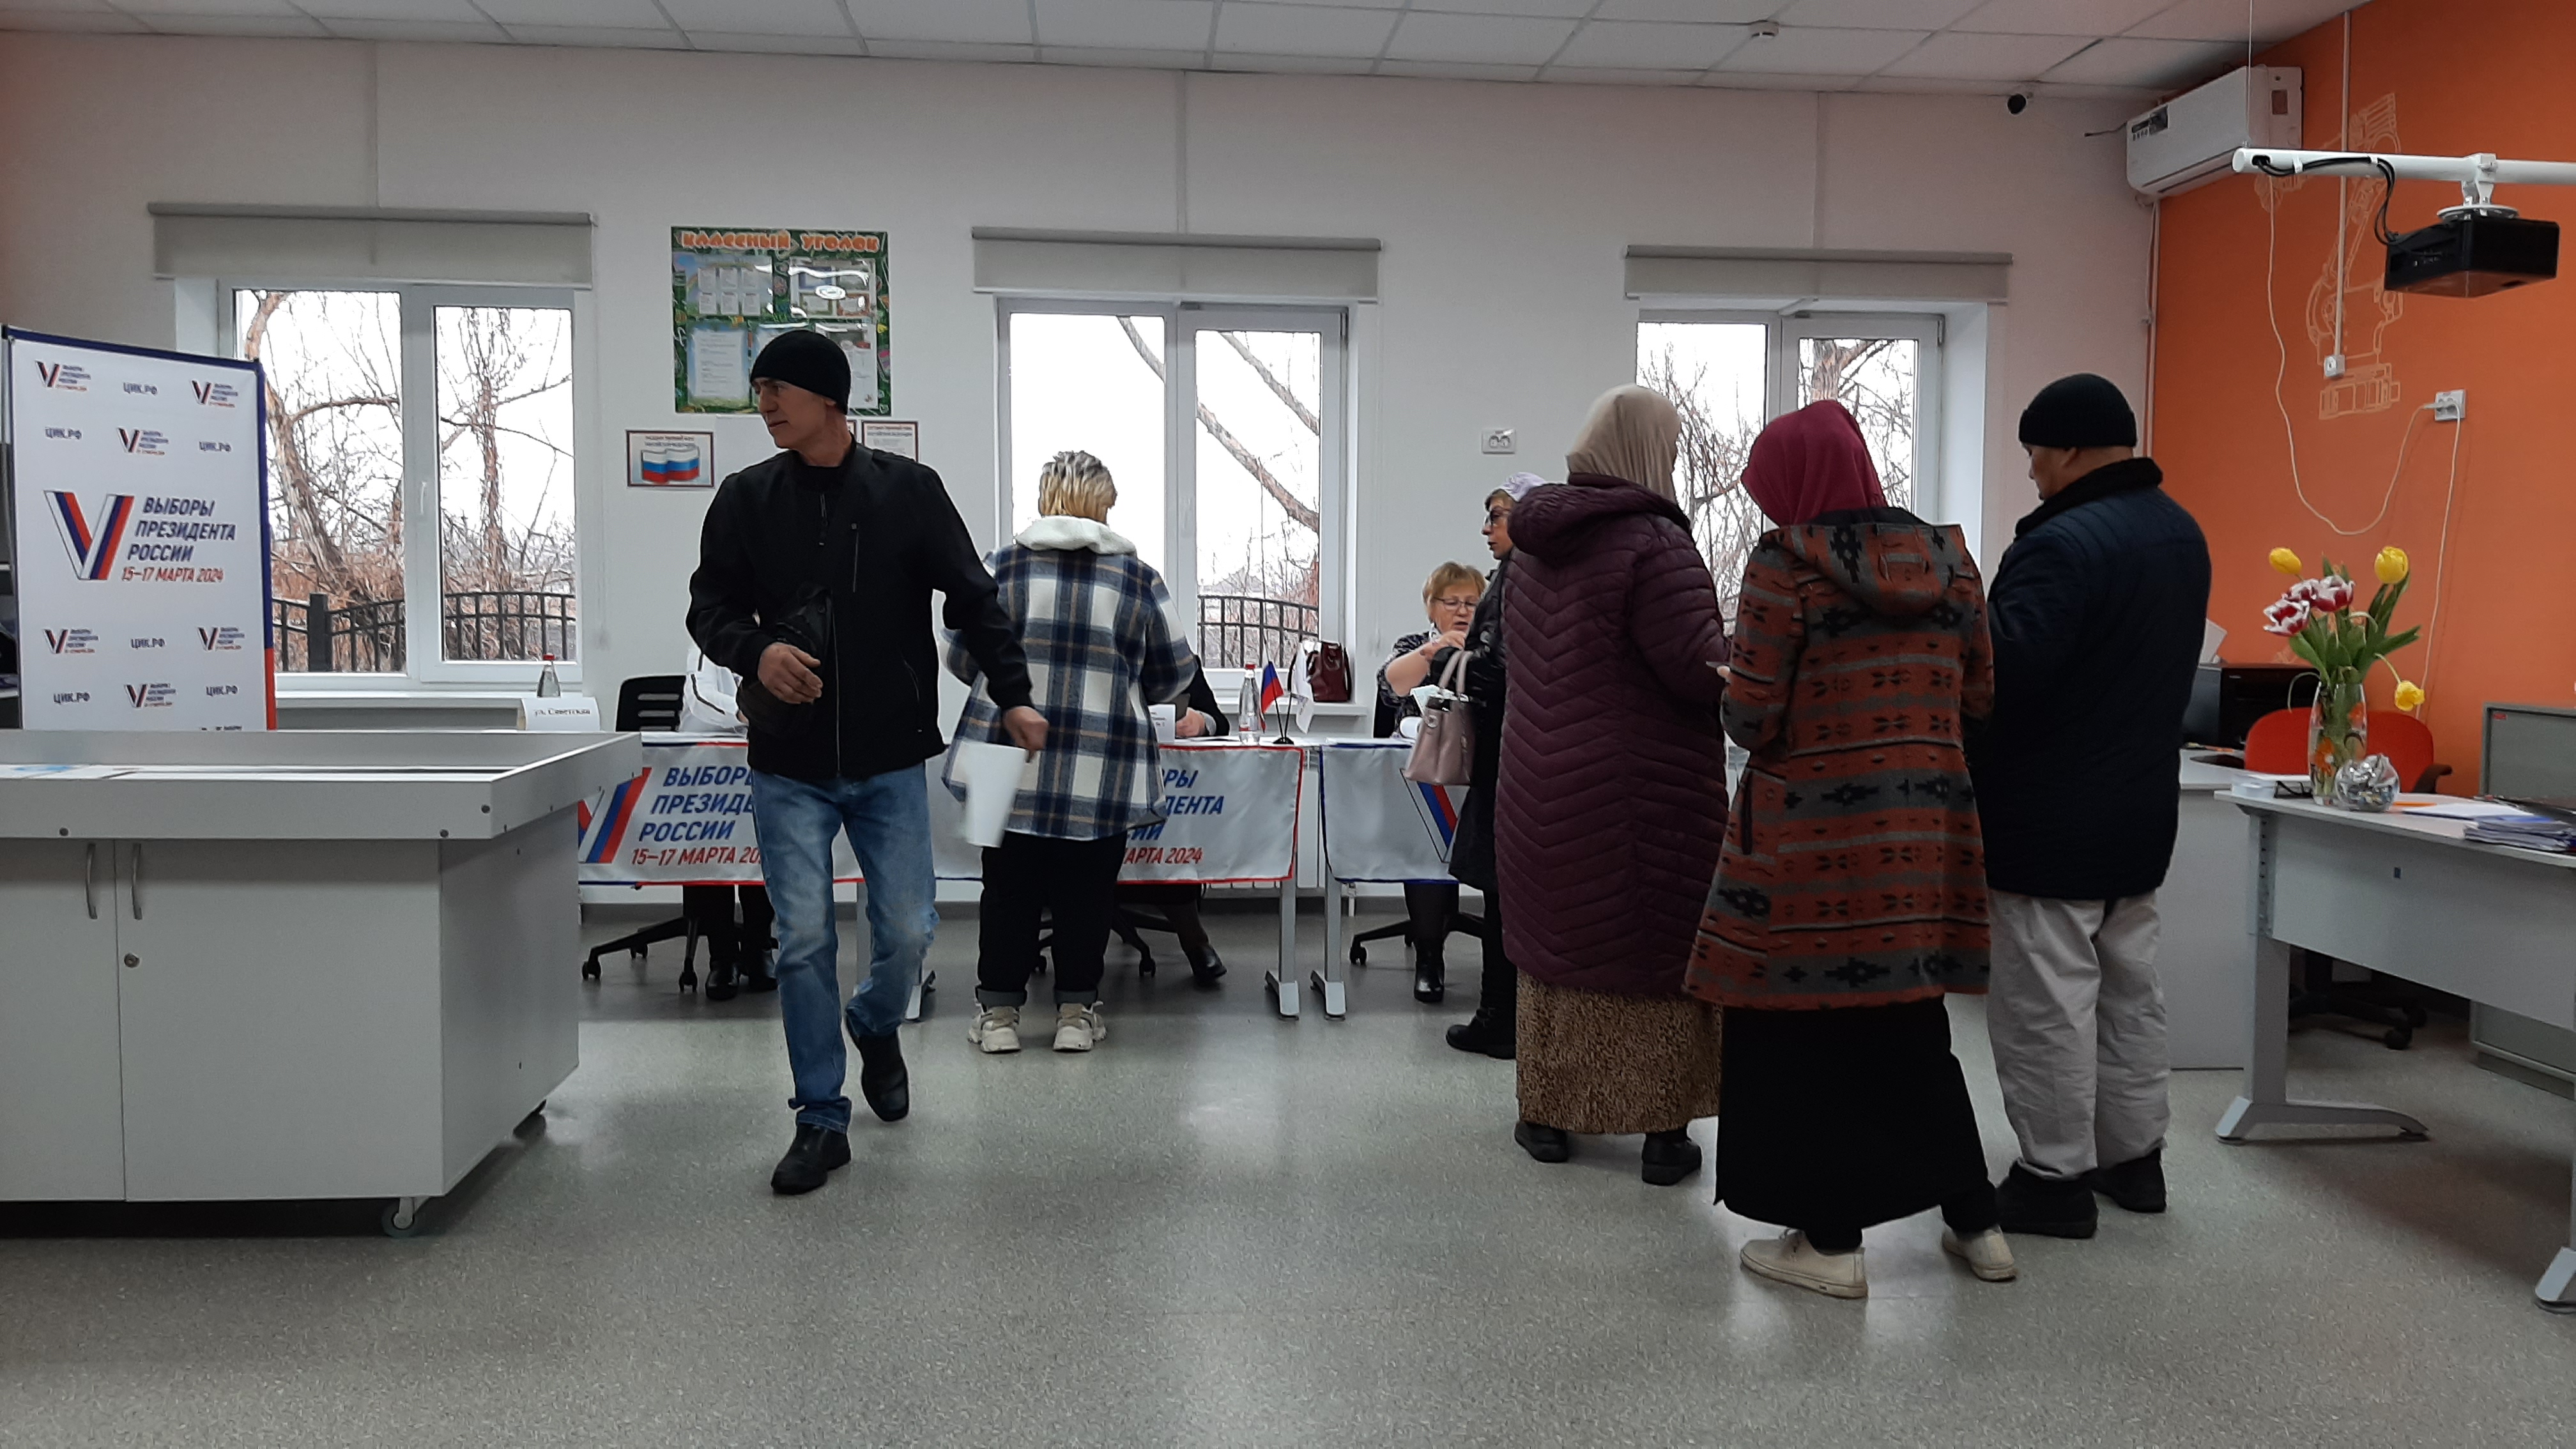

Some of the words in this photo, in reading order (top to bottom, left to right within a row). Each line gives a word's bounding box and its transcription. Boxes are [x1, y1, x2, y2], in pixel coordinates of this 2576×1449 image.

[682, 231, 790, 250] КЛАССНЫЙ
[801, 233, 879, 253] УГОЛОК
[143, 497, 215, 516] ВЫБОРЫ
[135, 520, 236, 541] ПРЕЗИДЕНТА
[128, 544, 194, 562] РОССИИ
[156, 567, 195, 583] МАРТА
[197, 567, 224, 583] 2024
[639, 820, 736, 842] РОССИИ
[678, 847, 737, 865] МАРТА
[739, 847, 760, 864] 20
[1124, 847, 1163, 864] АРТА
[1165, 847, 1203, 864] 2024
